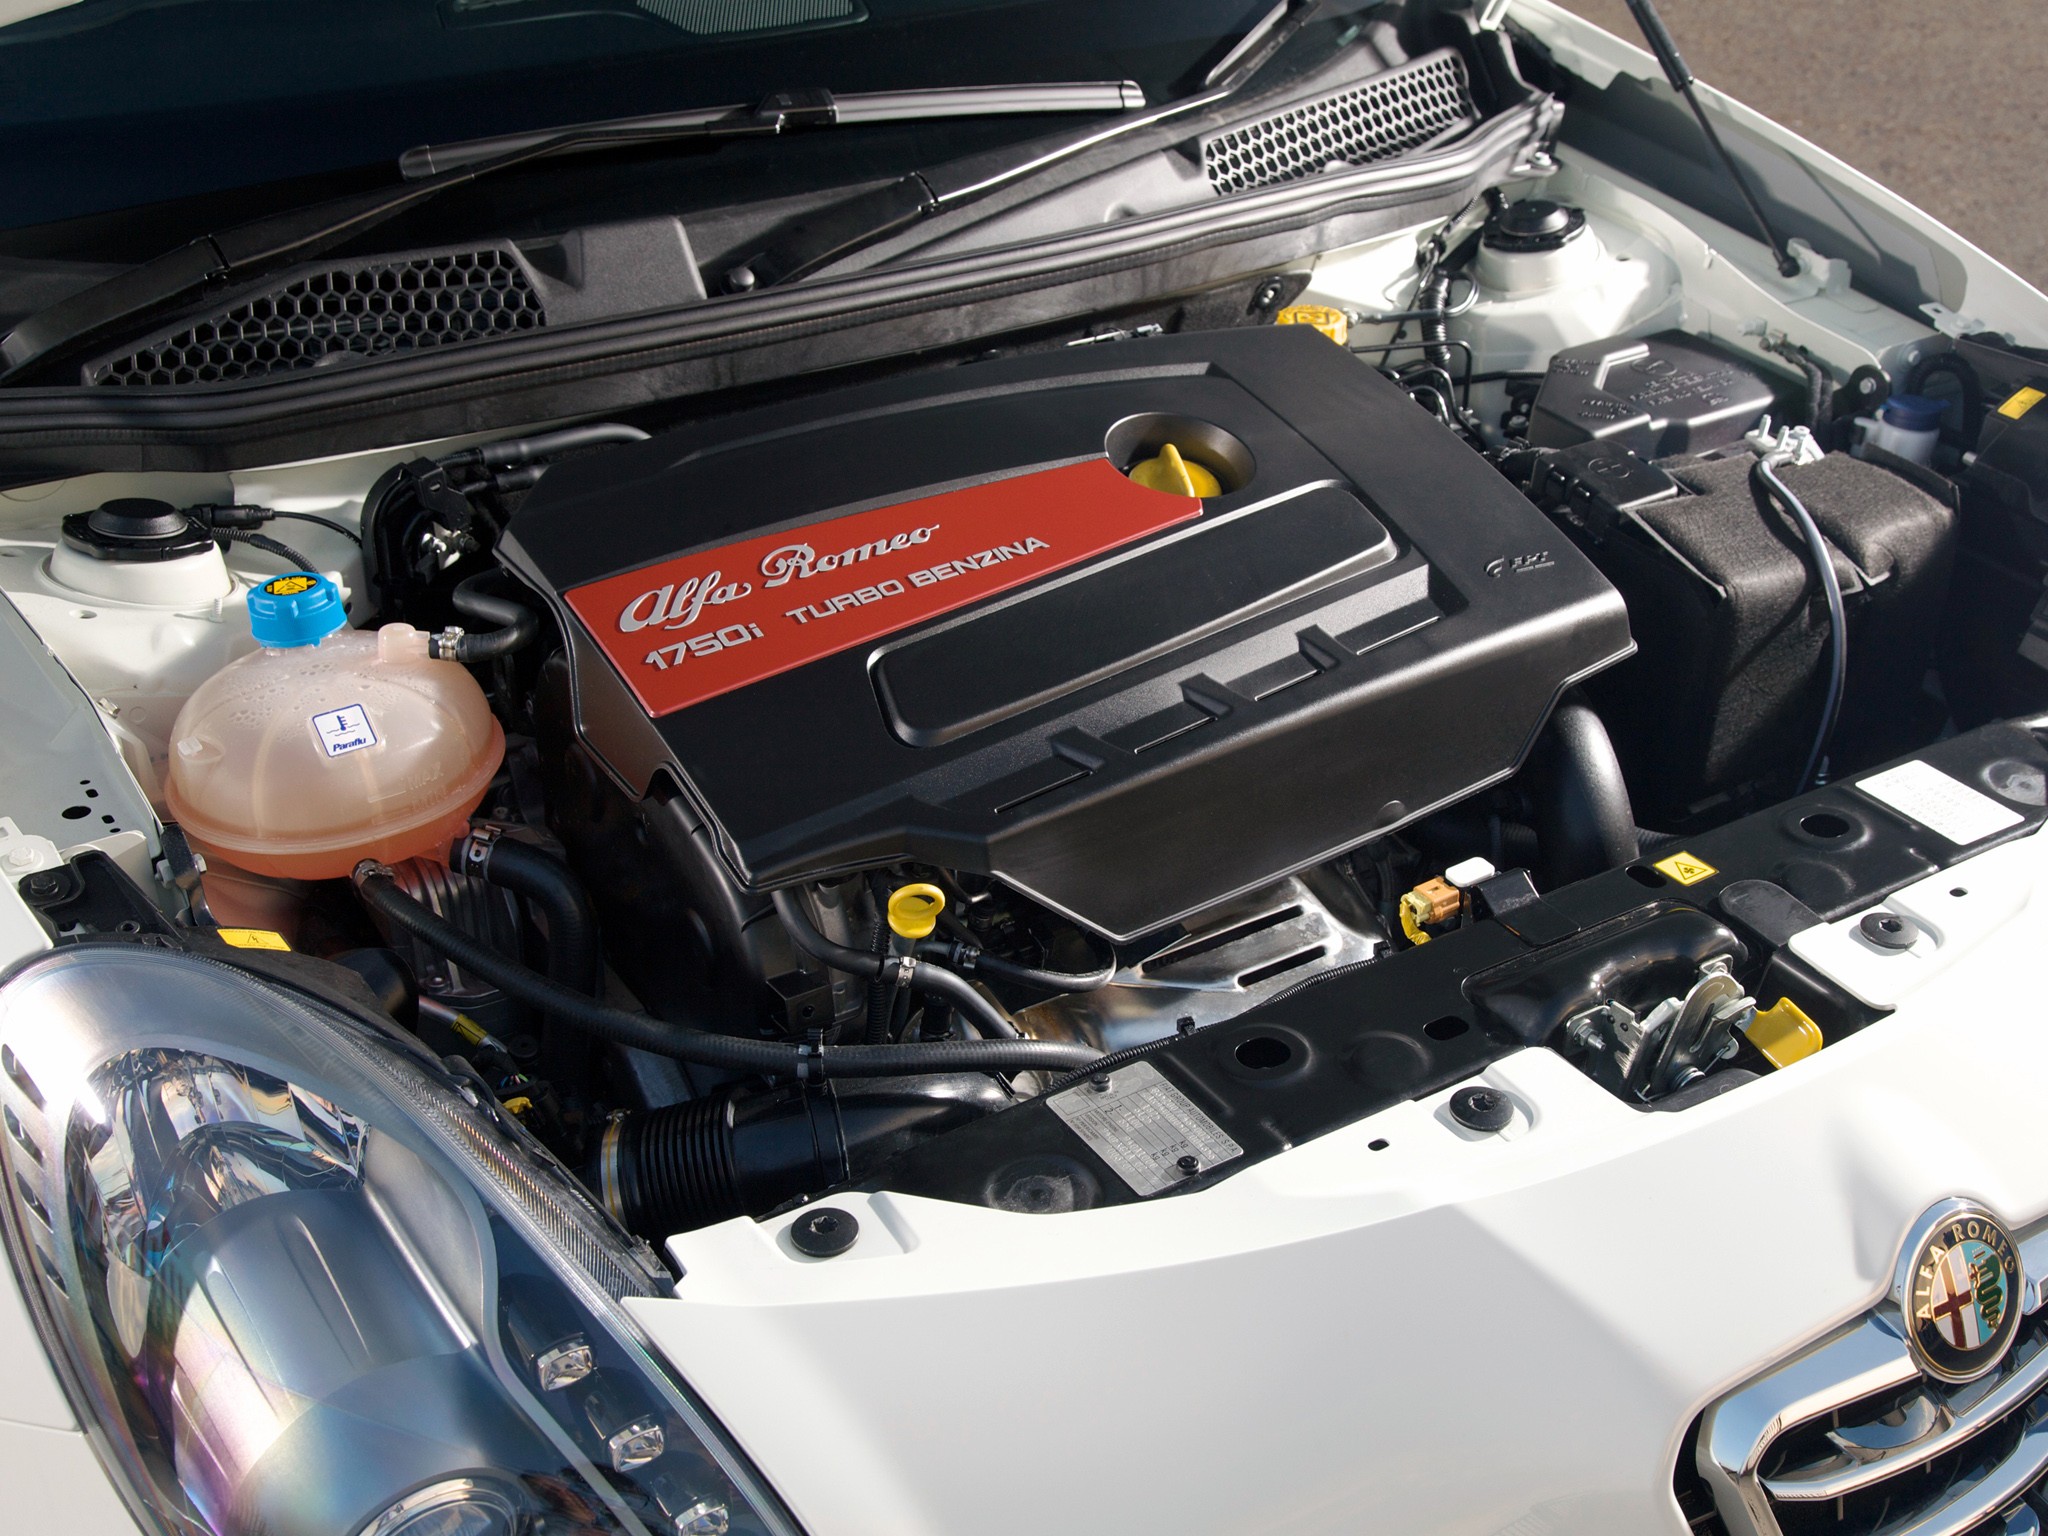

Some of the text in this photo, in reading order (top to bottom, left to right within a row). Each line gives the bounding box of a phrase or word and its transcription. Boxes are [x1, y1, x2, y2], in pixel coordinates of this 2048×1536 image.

[619, 524, 940, 632] Alfa Romeo
[645, 536, 1050, 670] 1750i TURBO BENZINA
[333, 738, 366, 752] Paraflu
[1159, 1082, 1174, 1093] FIAT
[1169, 1092, 1191, 1108] GROUP
[1186, 1107, 1224, 1138] AUTOMOBILES
[1168, 1144, 1181, 1152] kg
[1177, 1139, 1190, 1148] kg
[1149, 1152, 1162, 1161] kg
[1159, 1148, 1171, 1156] kg
[1916, 1220, 2016, 1319] ALFA ROMEO
